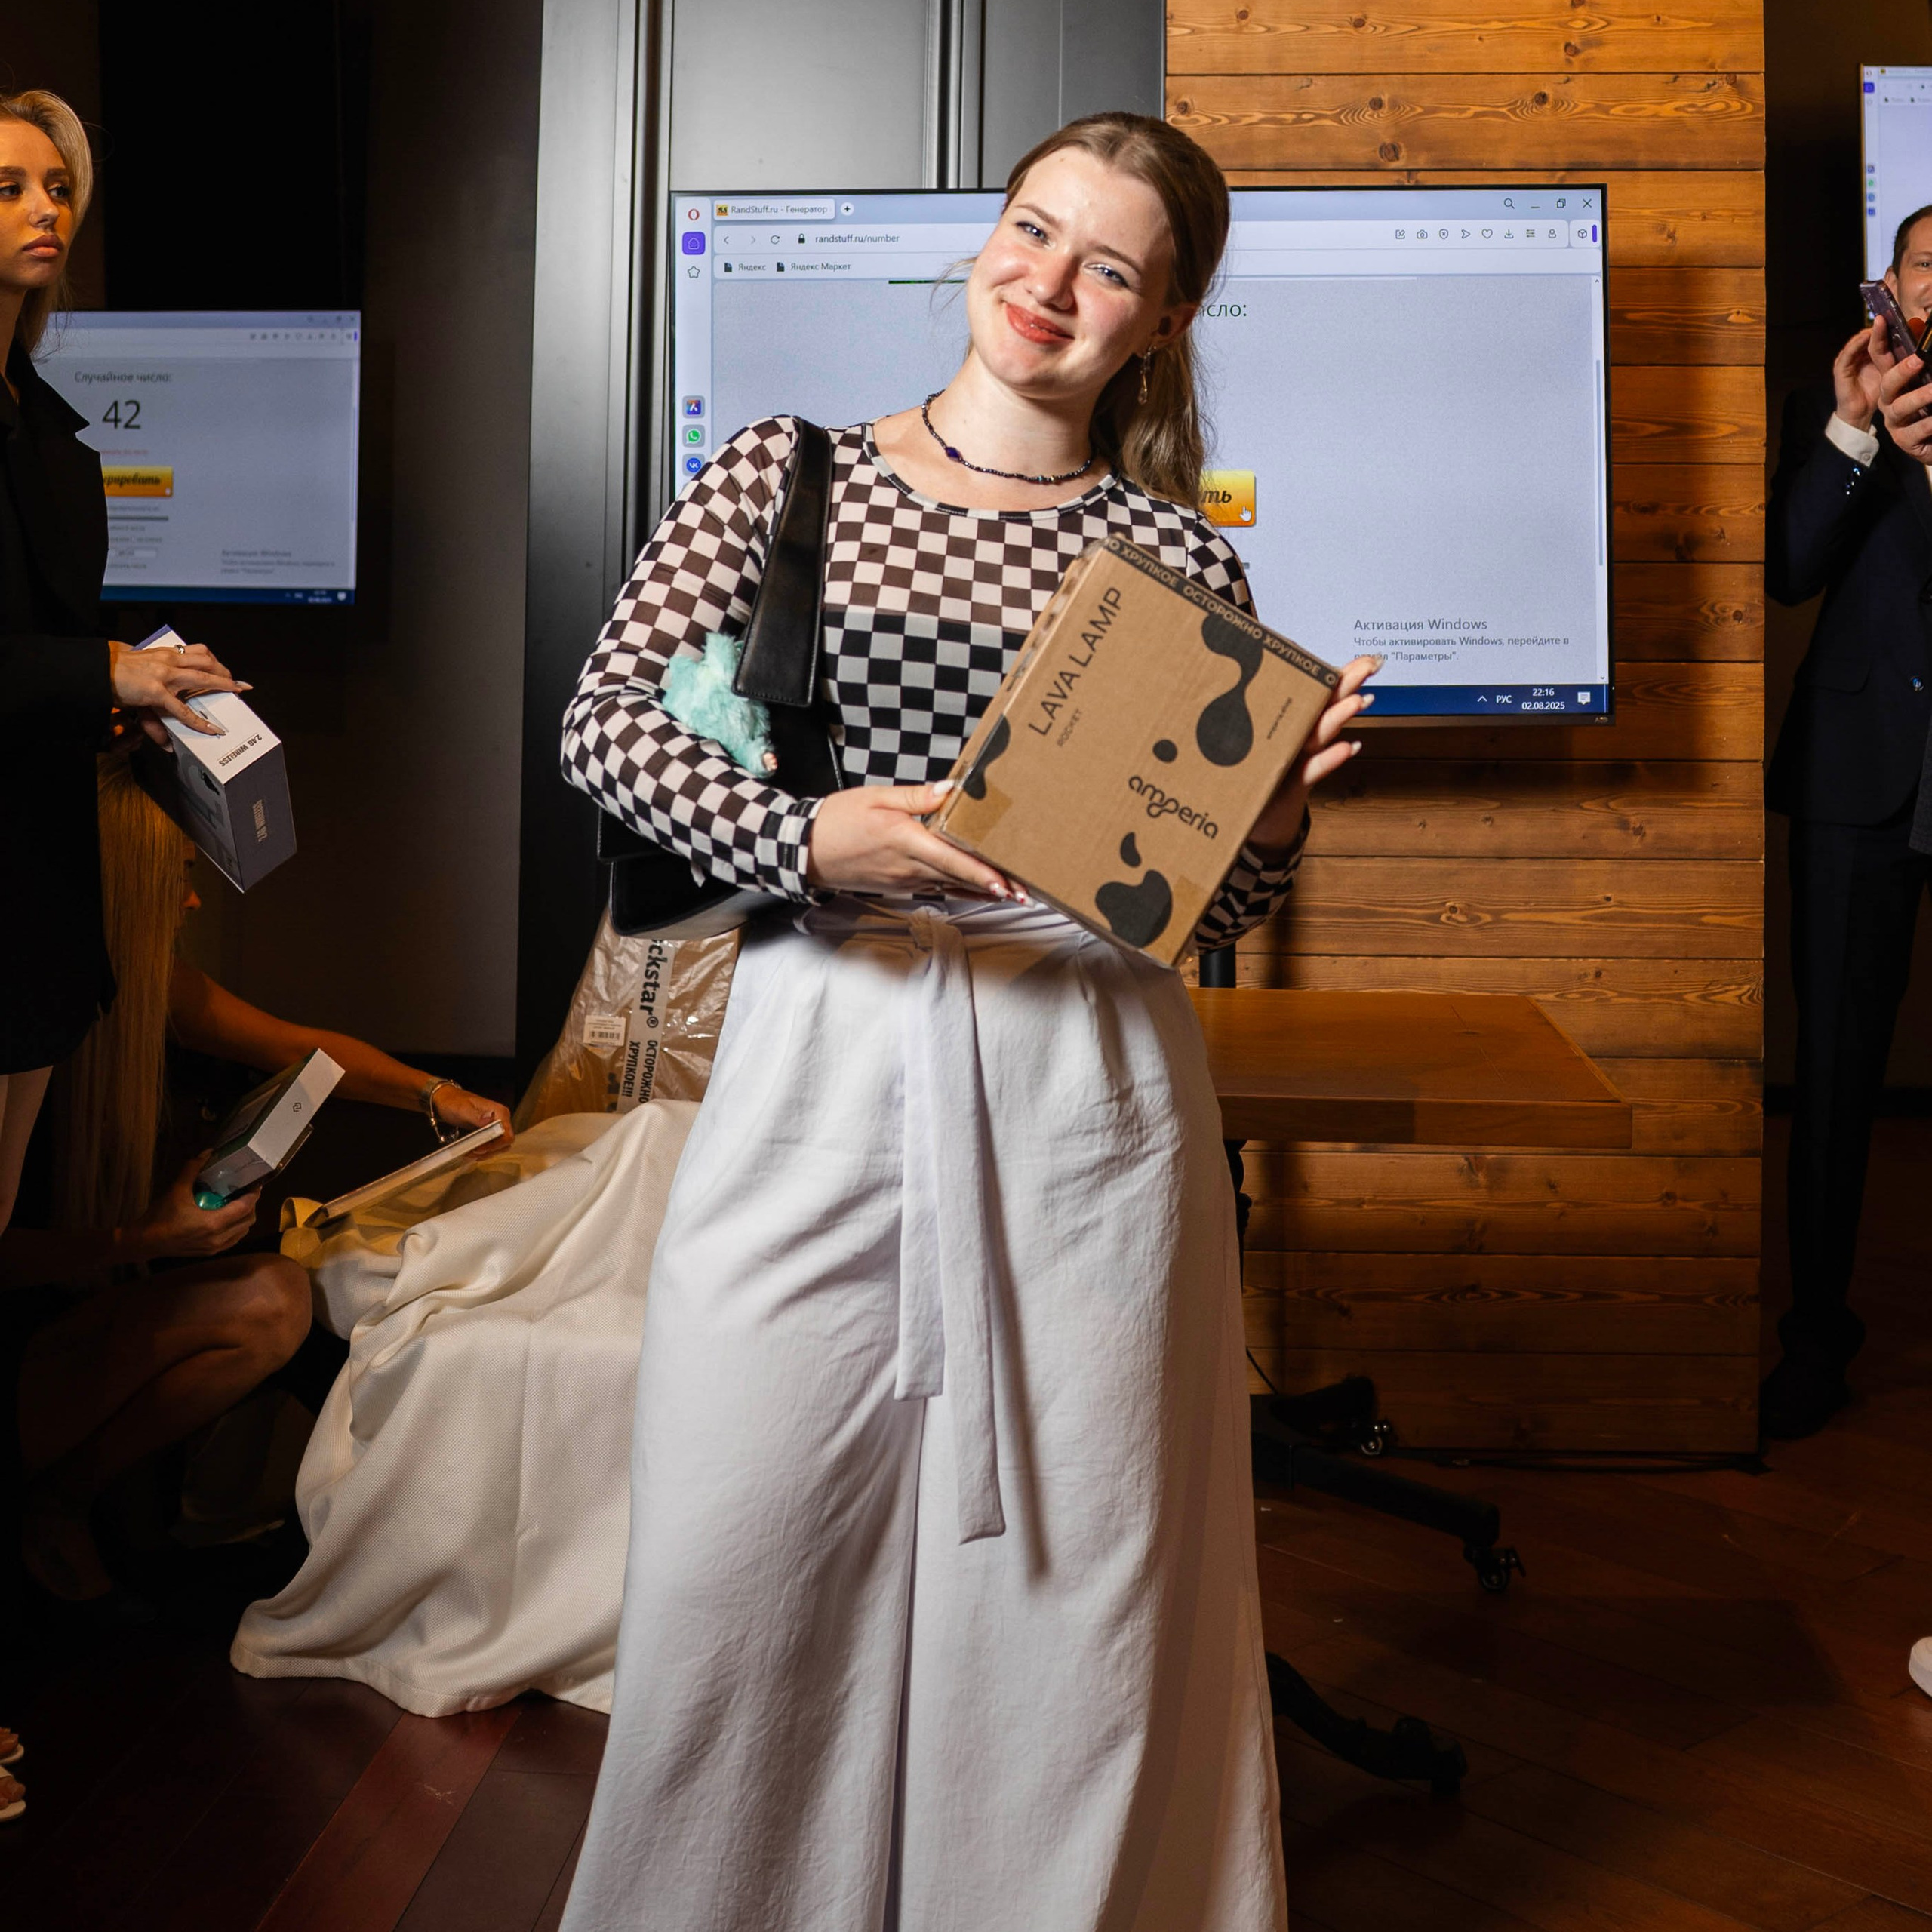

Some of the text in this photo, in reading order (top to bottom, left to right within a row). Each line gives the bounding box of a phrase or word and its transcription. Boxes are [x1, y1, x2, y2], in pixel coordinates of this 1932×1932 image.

[731, 205, 778, 214] RandStuff.ru
[786, 206, 827, 214] Генератор
[815, 233, 900, 244] randstuff.ru/number
[738, 263, 766, 272] Яндекс
[791, 262, 851, 272] Яндекс Маркет
[101, 399, 141, 429] 42
[1201, 490, 1232, 504] ть
[1120, 547, 1180, 587] ХРУПКОЕ
[1183, 585, 1263, 639] ОСТОРОЖНО
[1263, 633, 1321, 677] ХРУПКОЕ
[1353, 617, 1487, 632] Активация Windows
[1354, 637, 1386, 647] Чтобы
[1389, 638, 1457, 648] активировать
[1458, 636, 1504, 647] Windows,
[1507, 636, 1561, 647] перейдите
[1028, 587, 1121, 736] LAVA LAMP
[1391, 651, 1459, 662] "Параметры".
[1532, 688, 1555, 697] 22:16
[1496, 695, 1512, 704] РУС
[1521, 701, 1565, 711] 02.08.2025
[1057, 707, 1082, 747] ROCKET
[218, 734, 263, 767] 2.4G WIRELESS
[622, 1040, 641, 1098] ХРУПКОЕ!!!
[638, 1040, 658, 1103] ОСТОРОЖНО
